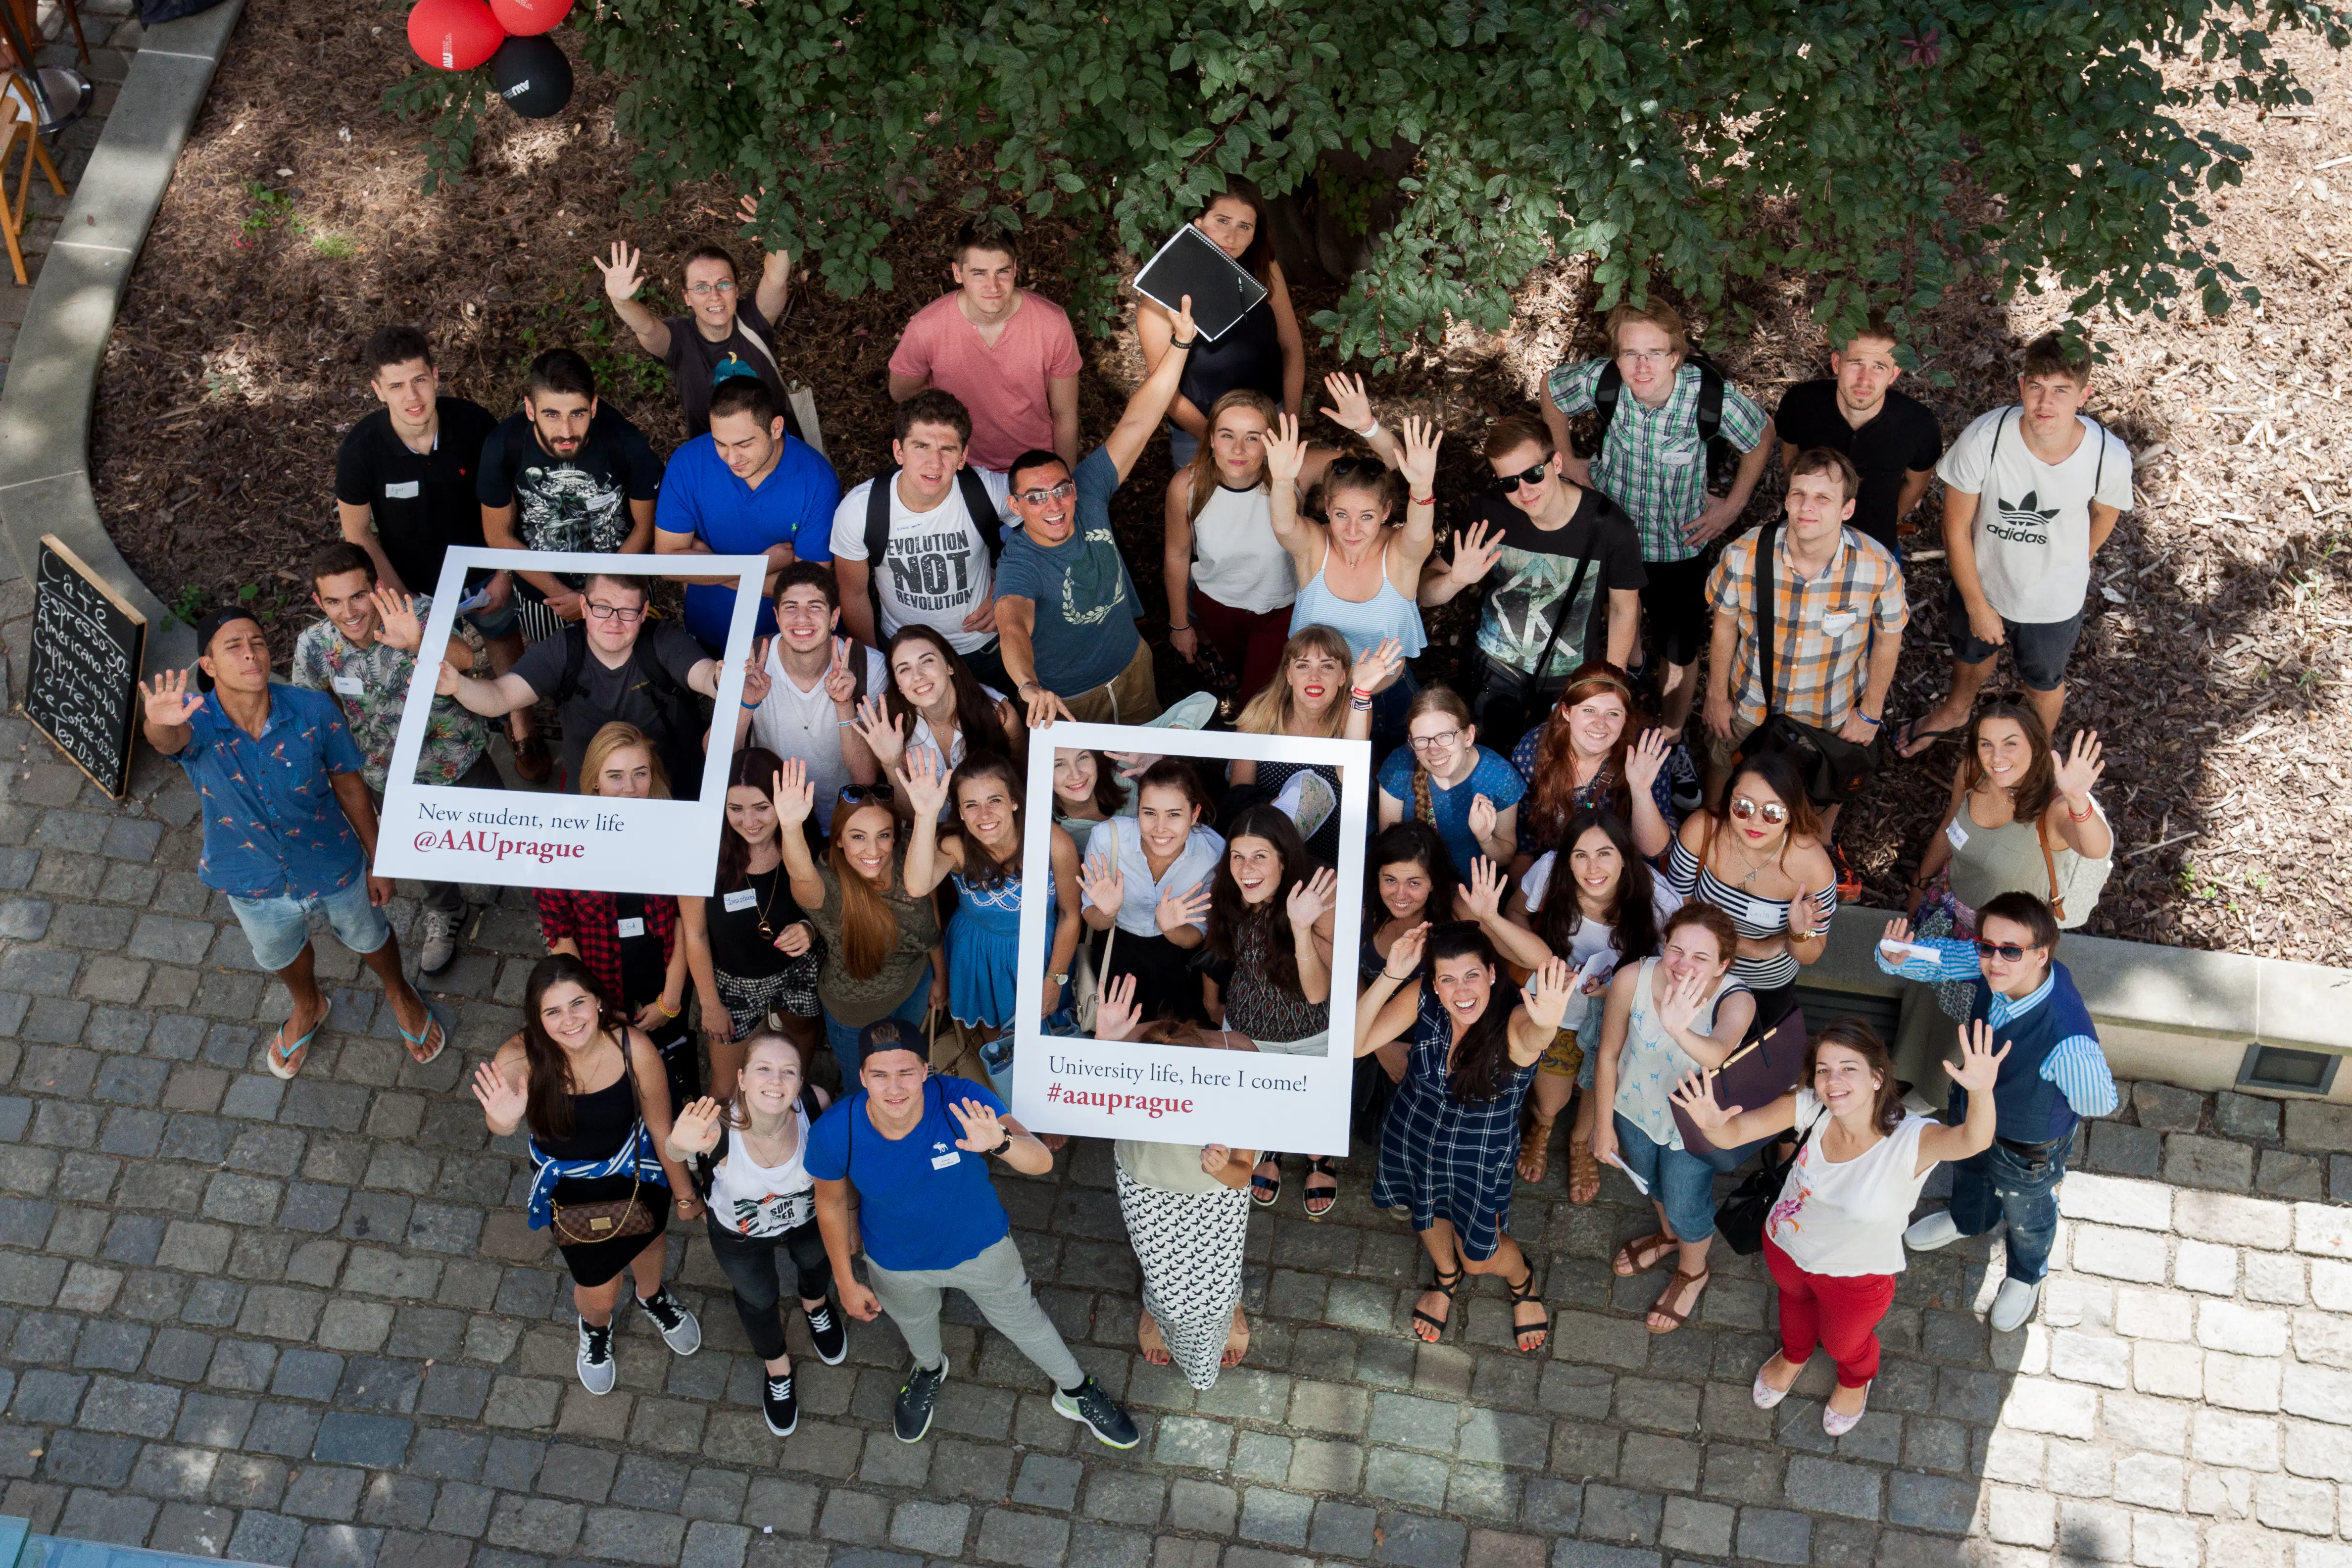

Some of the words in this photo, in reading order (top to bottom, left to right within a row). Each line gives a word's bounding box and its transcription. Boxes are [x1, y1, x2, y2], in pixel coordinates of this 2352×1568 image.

[886, 530, 969, 556] EVOLUTION
[1987, 524, 2047, 544] adidas
[888, 549, 971, 595] NOT
[895, 588, 974, 611] REVOLUTION
[418, 803, 462, 821] New
[468, 807, 542, 830] student,
[551, 817, 590, 830] new
[595, 813, 625, 832] life
[414, 829, 585, 864] @AAUprague
[1050, 1056, 1144, 1085] University
[1150, 1063, 1183, 1085] life,
[1191, 1066, 1231, 1086] here
[1238, 1070, 1244, 1088] I
[1252, 1075, 1307, 1092] come!
[1047, 1082, 1194, 1119] #aauprague
[770, 1200, 793, 1216] SUM
